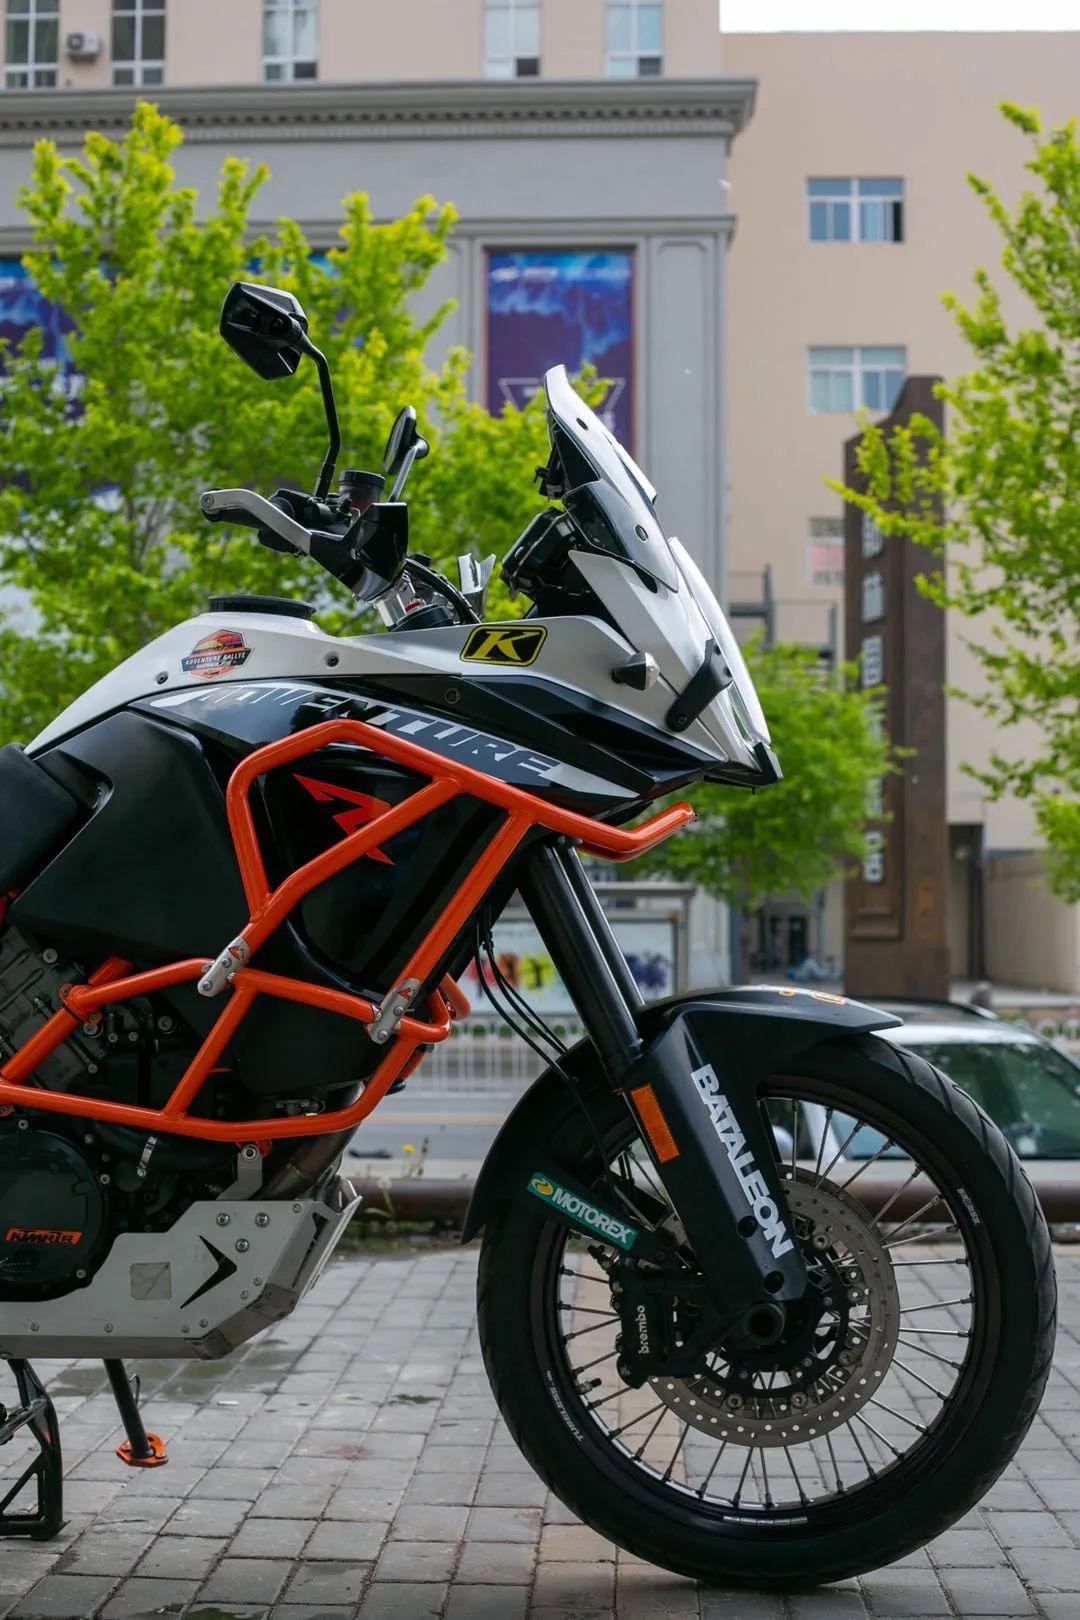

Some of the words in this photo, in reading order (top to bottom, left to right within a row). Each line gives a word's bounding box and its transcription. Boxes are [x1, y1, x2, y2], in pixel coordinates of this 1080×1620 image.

[185, 656, 221, 665] ADVENTURE
[690, 1063, 795, 1259] BATALEON
[551, 1187, 632, 1244] MOTOREX
[634, 1304, 651, 1355] brembo
